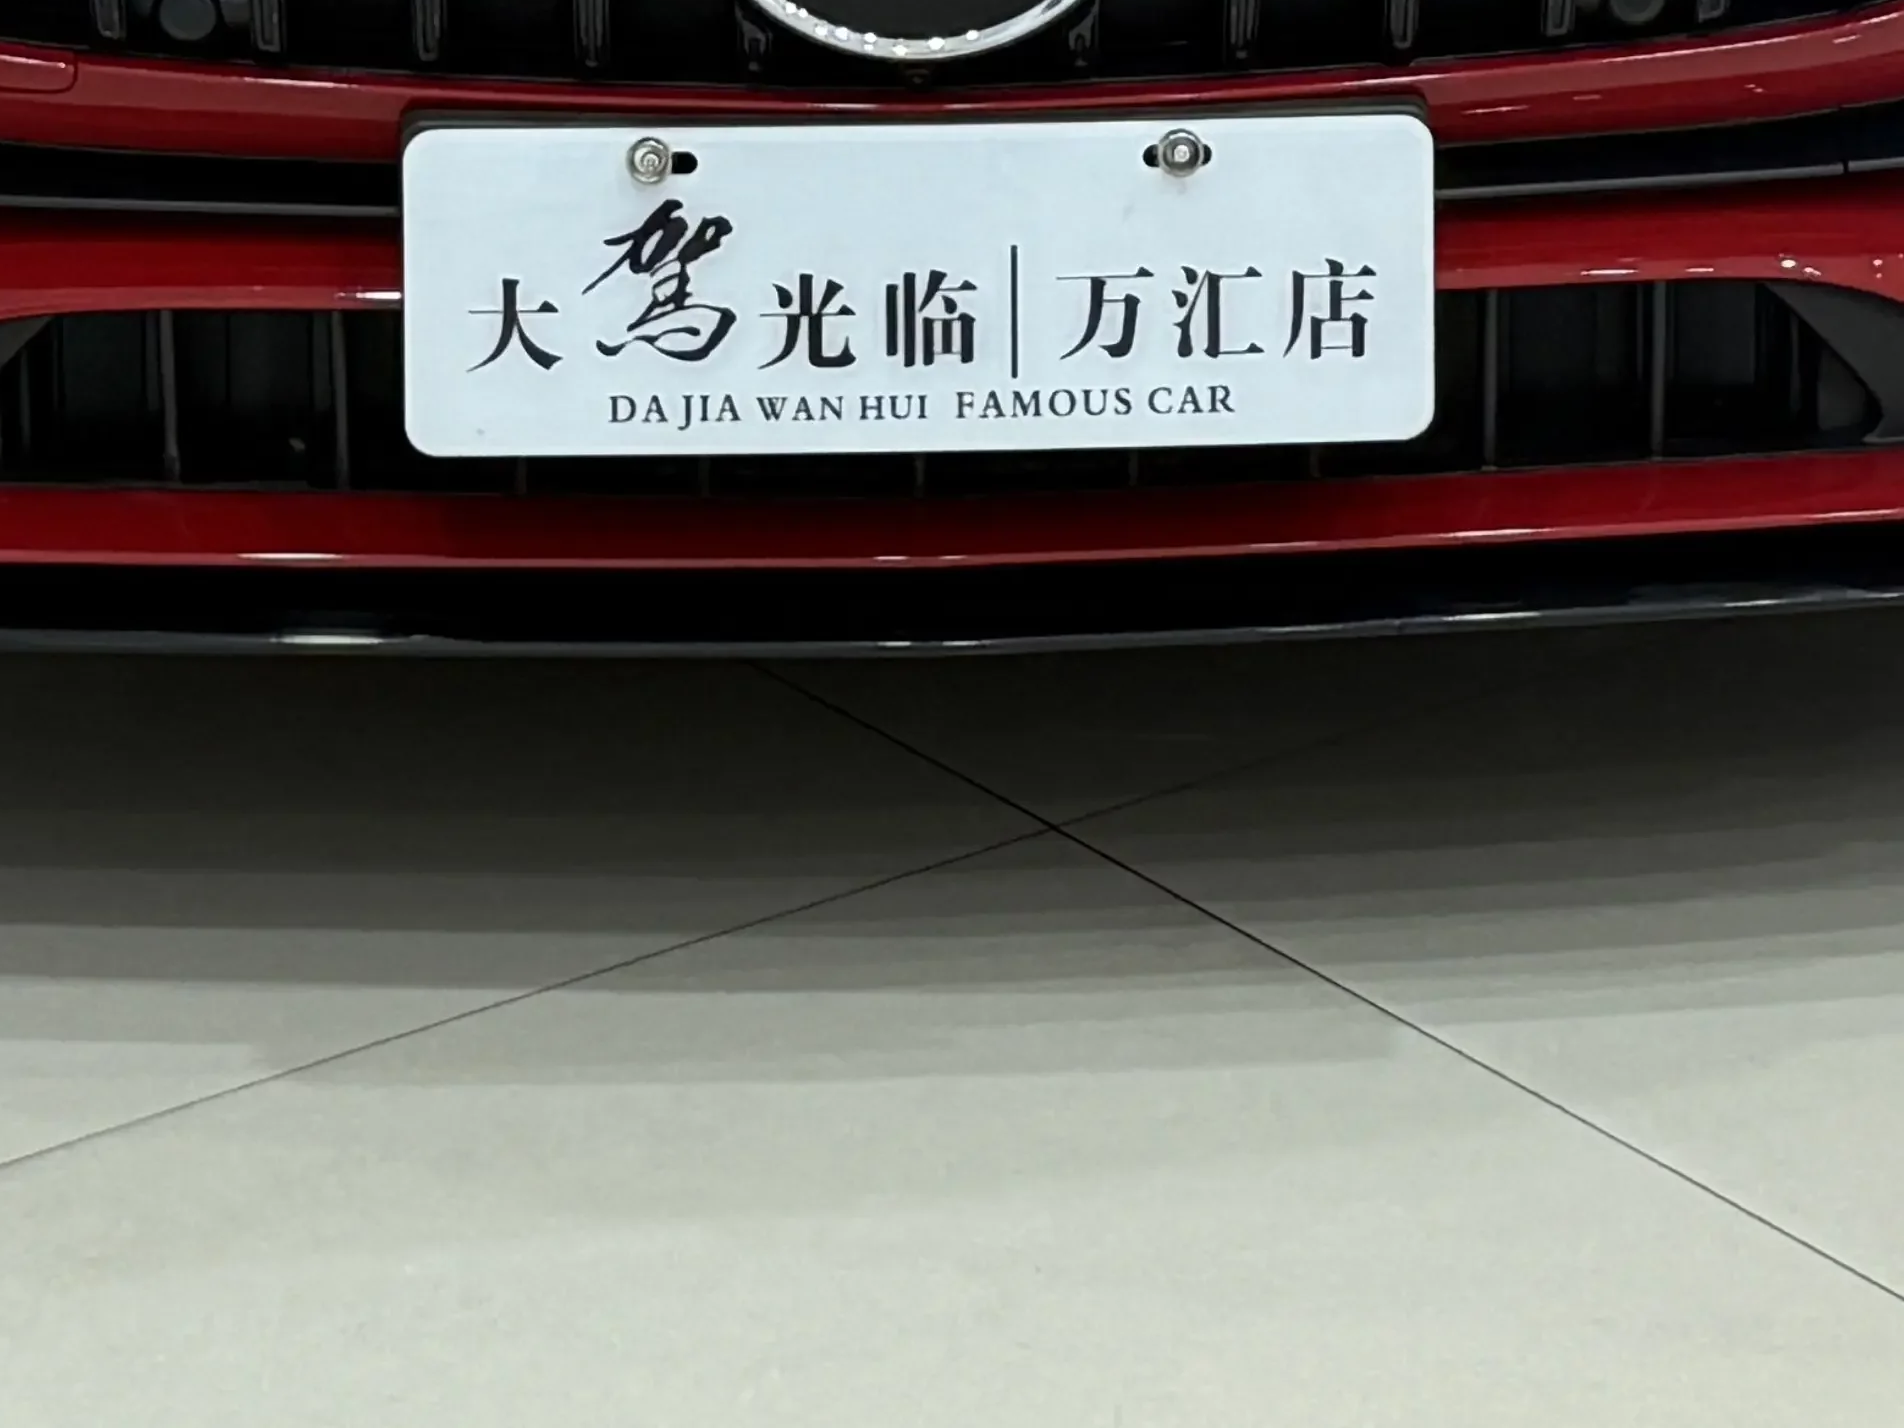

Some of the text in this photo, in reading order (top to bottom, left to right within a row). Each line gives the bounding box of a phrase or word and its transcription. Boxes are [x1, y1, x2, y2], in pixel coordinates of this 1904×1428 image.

[1057, 256, 1378, 361] 万汇店
[755, 396, 844, 422] WAN
[858, 394, 929, 421] HUI
[954, 387, 1133, 419] FAMOUS
[1147, 384, 1236, 415] CAR
